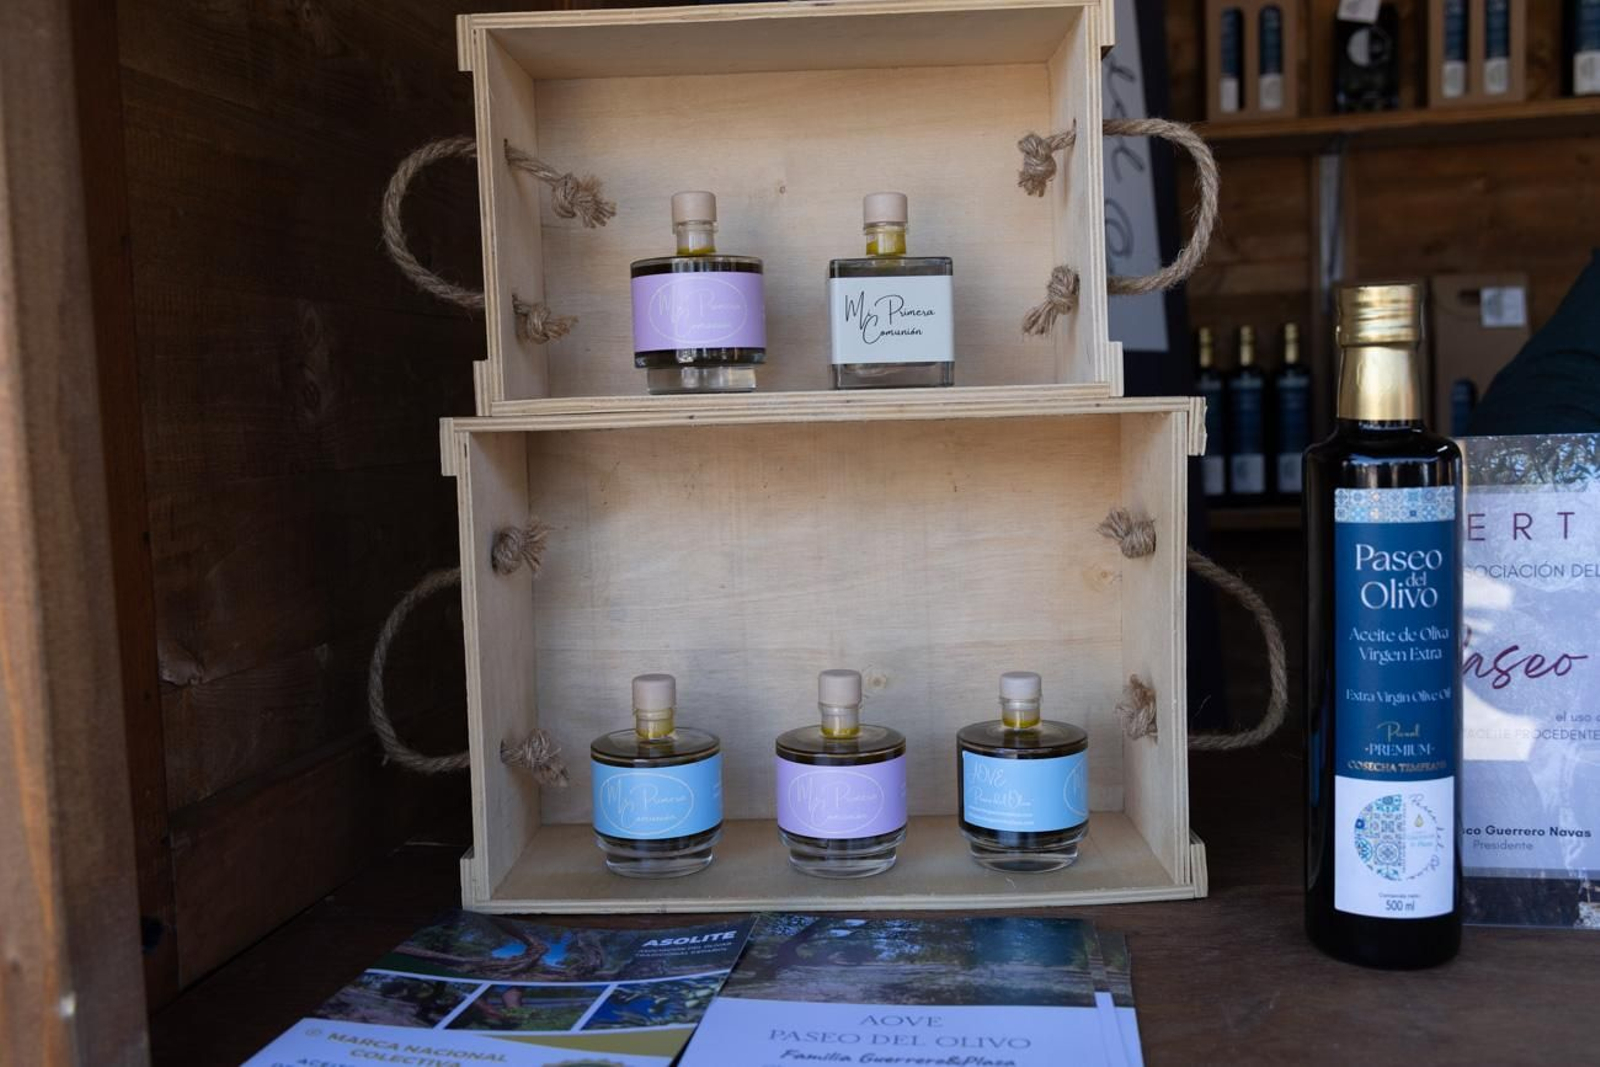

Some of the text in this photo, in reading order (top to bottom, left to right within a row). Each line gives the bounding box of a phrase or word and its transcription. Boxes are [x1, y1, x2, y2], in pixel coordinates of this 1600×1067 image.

[845, 290, 936, 330] Mi Primera
[862, 314, 923, 345] Comunión
[1356, 543, 1443, 571] Paseo
[1405, 571, 1427, 587] del
[1361, 578, 1438, 610] Olivo
[1349, 625, 1450, 642] Aceite de Oliva
[1359, 646, 1443, 666] Virgen Extra
[1346, 688, 1375, 702] Extra
[1376, 690, 1410, 706] Virgin
[1485, 824, 1546, 837] Guerrero
[1549, 826, 1592, 838] Navas
[1473, 839, 1534, 851] Presidente
[1386, 900, 1416, 911] 500 ml
[641, 930, 738, 947] ASOLITE
[860, 1014, 943, 1028] AOVE
[326, 1031, 508, 1063] MARCA NACIONAL
[768, 1028, 1031, 1050] PASEO DEL OLIVO
[349, 1047, 461, 1067] COLECTIVA
[780, 1049, 853, 1062] Familia
